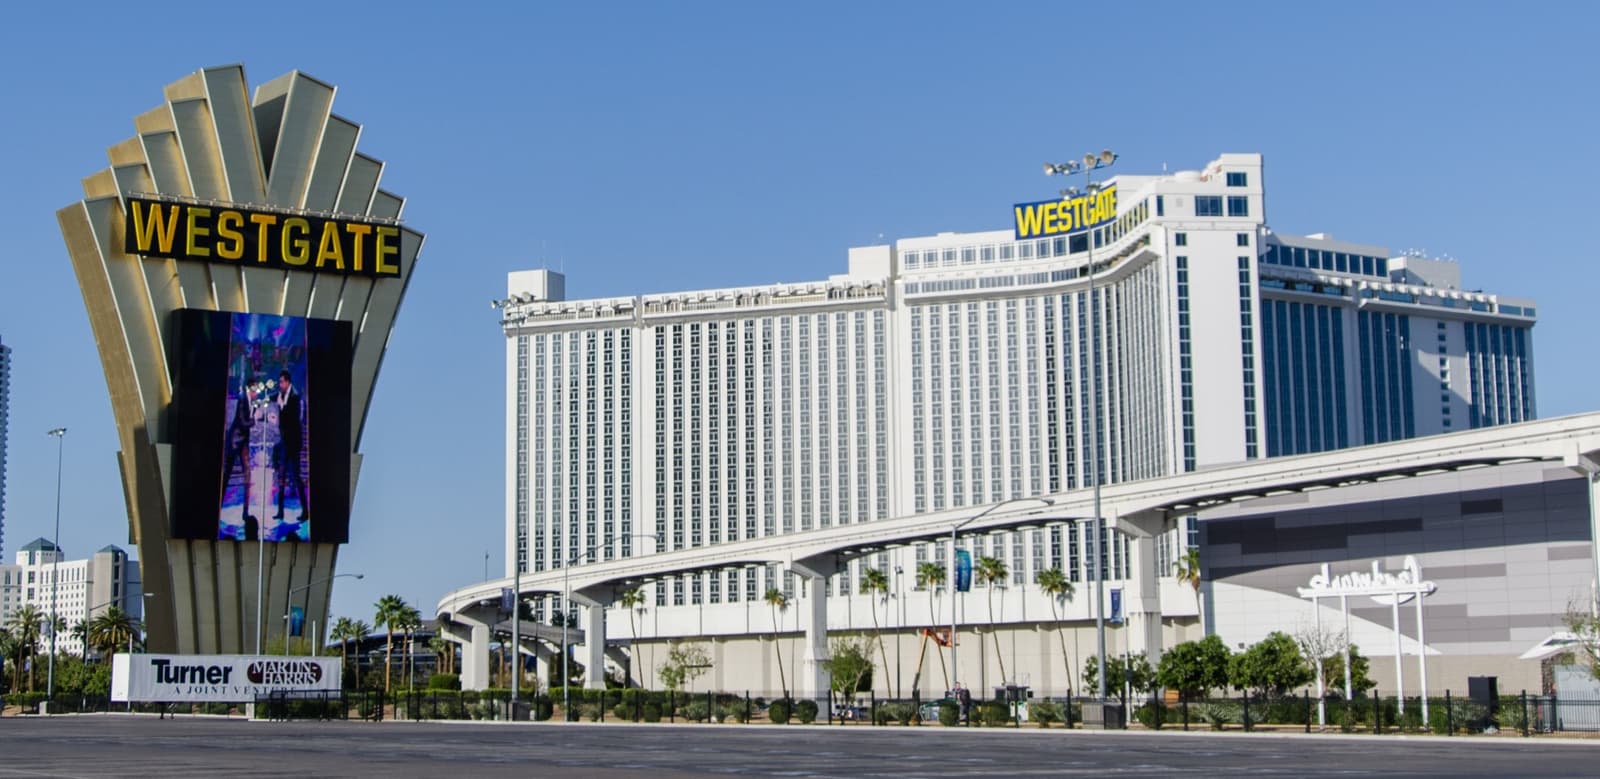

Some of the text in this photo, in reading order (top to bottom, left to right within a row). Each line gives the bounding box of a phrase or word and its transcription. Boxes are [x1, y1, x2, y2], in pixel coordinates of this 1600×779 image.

[1015, 184, 1117, 238] WESTGATE
[131, 200, 399, 274] WESTGATE
[151, 658, 233, 685] Turner
[262, 672, 317, 685] HARRIS
[175, 686, 181, 695] A
[187, 686, 226, 695] JOINT
